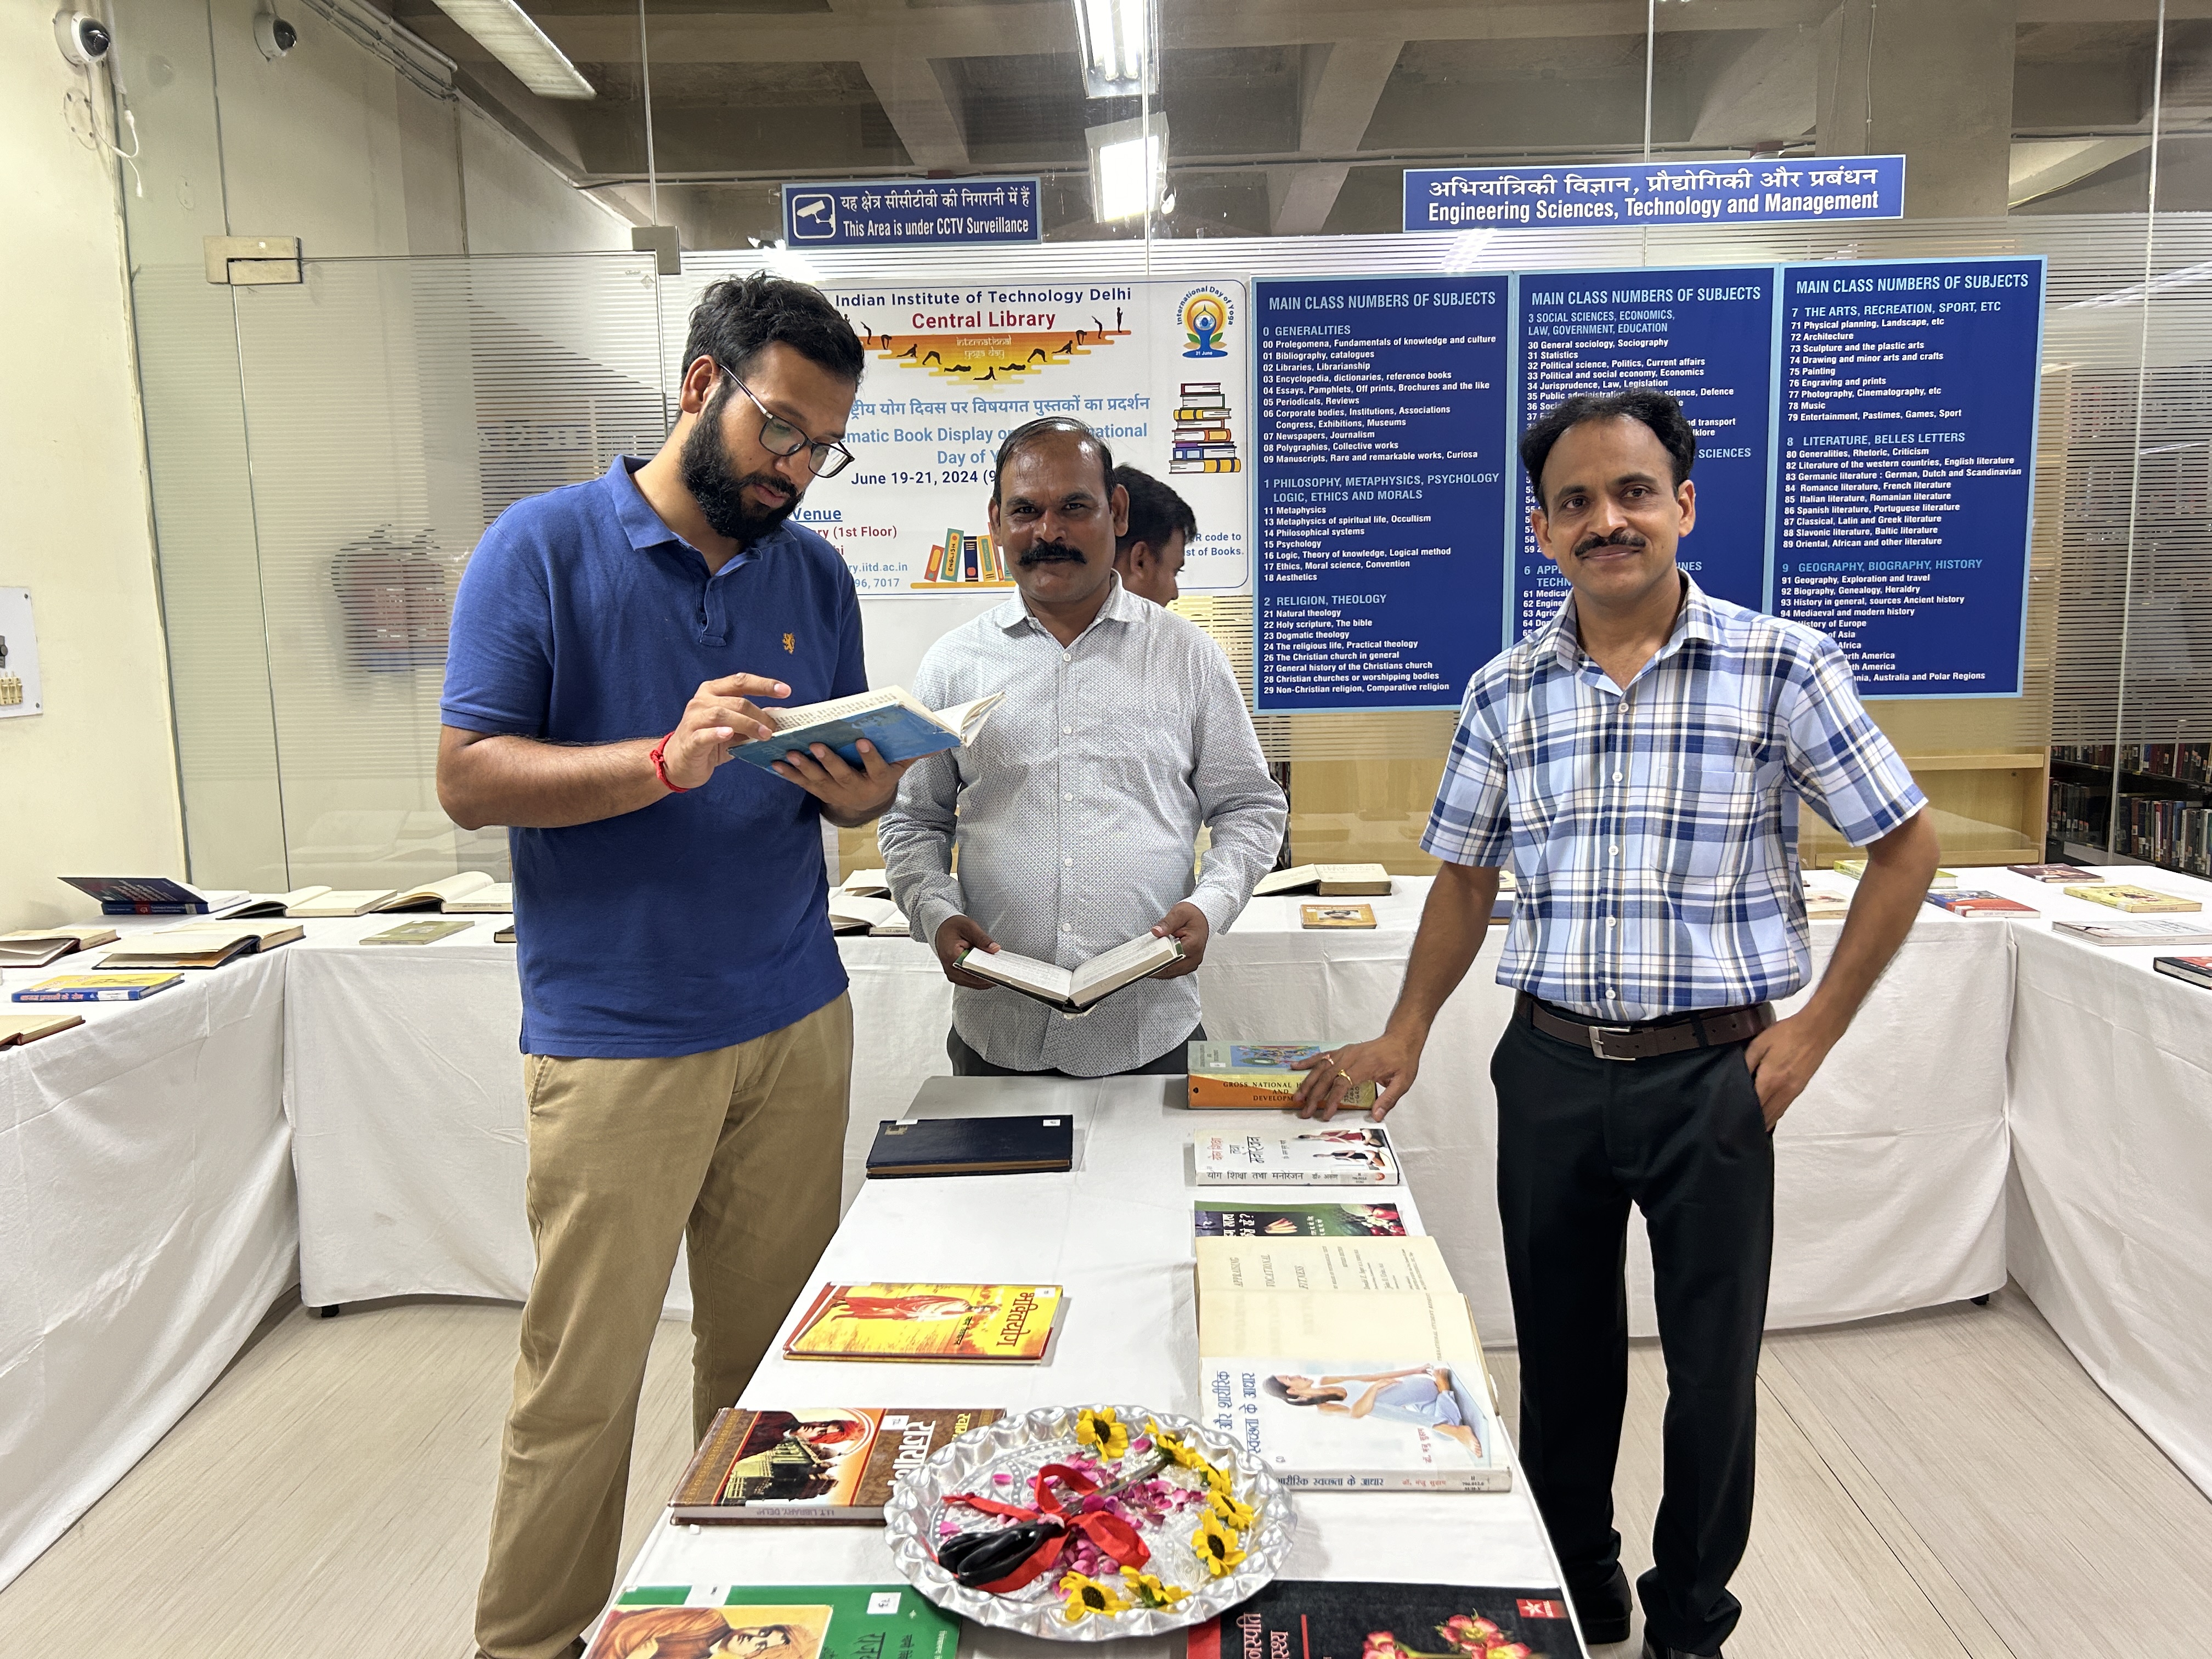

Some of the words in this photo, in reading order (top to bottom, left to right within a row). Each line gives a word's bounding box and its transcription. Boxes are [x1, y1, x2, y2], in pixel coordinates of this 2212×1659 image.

[1429, 173, 1558, 197] अभियांत्रिकी
[1563, 173, 1639, 196] विज्ञान,
[1645, 167, 1754, 192] प्रौद्योगिकी
[1759, 166, 1804, 188] और
[1808, 165, 1879, 187] प्रबंधन
[839, 196, 859, 212] यह
[861, 190, 882, 213] क्षेत्र
[884, 189, 938, 210] सीसीटीवी
[940, 188, 958, 207] की
[961, 187, 1005, 207] निगरानी
[1007, 186, 1018, 205] में
[1020, 186, 1030, 207] हैं
[1429, 201, 1530, 224] Engineering
[1536, 199, 1618, 219] Sciences,
[1624, 196, 1722, 217] Technology
[1727, 194, 1759, 213] and
[1765, 190, 1879, 215] Management
[843, 220, 865, 237] This
[867, 220, 891, 236] Area
[893, 219, 902, 236] is
[905, 218, 934, 235] under
[936, 217, 963, 235] CCTV
[967, 216, 1029, 234] Surveillance
[1796, 280, 1829, 294] MAIN
[1833, 278, 1874, 293] CLASS
[1877, 276, 1940, 291] NUMBERS
[1944, 275, 1961, 289] OF
[1965, 274, 2029, 289] SUBJECTS
[836, 294, 885, 307] Indian
[891, 292, 960, 306] Institute
[966, 291, 982, 304] of
[988, 289, 1084, 304] Technology
[1090, 287, 1131, 301] Delhi
[1269, 296, 1301, 310] MAIN
[1305, 295, 1344, 309] CLASS
[1348, 294, 1409, 308] NUMBERS
[1413, 293, 1430, 307] OF
[1433, 291, 1496, 306] SUBJECTS
[1176, 285, 1207, 325] International
[1209, 286, 1223, 297] Day
[912, 311, 981, 329] Central
[989, 310, 1056, 330] Library
[1263, 326, 1269, 336] 0
[1275, 325, 1351, 336] GENERALITIES
[1528, 325, 1550, 337] LAW,
[1553, 324, 1615, 335] GOVERNMENT,
[1618, 323, 1668, 334] EDUCATION
[1790, 333, 1802, 341] 72
[1803, 332, 1854, 341] Architecture
[956, 336, 1012, 346] international
[964, 350, 986, 360] yoga
[988, 348, 1005, 359] day
[1527, 352, 1537, 360] 31
[1541, 351, 1578, 359] Statistics
[1263, 364, 1273, 372] 02
[1276, 363, 1314, 372] Libraries,
[1317, 362, 1370, 371] Librarianship
[879, 398, 906, 415] योग
[909, 398, 947, 415] दिवस
[950, 402, 969, 414] पर
[972, 397, 1030, 414] विषयगत
[1032, 394, 1081, 416] पुस्तकों
[1084, 398, 1104, 411] का
[1107, 393, 1150, 411] प्रदर्शन
[1276, 397, 1323, 406] Periodicals,
[1325, 397, 1359, 405] Reviews
[1787, 413, 1798, 421] 79
[1800, 412, 1860, 421] Entertainment,
[1863, 411, 1903, 420] Pastimes,
[1905, 410, 1937, 419] Games,
[1939, 409, 1962, 419] Sport
[841, 428, 890, 443] matic
[894, 427, 933, 442] Book
[937, 426, 994, 444] Display
[1088, 422, 1147, 438] national
[937, 450, 966, 466] Day
[970, 449, 986, 464] of
[1698, 447, 1751, 459] SCIENCES
[851, 472, 886, 485] June
[891, 471, 937, 486] 19-21,
[942, 470, 978, 483] 2024
[793, 507, 842, 520] Venue
[833, 526, 857, 540] (1st
[861, 525, 897, 539] Floor)
[1194, 533, 1202, 541] R
[1205, 532, 1229, 541] code
[1231, 533, 1242, 541] to
[1276, 528, 1329, 538] Philosophical
[1331, 528, 1365, 537] systems
[948, 543, 956, 572] ENGLISH
[1186, 548, 1195, 556] st
[1198, 547, 1208, 556] of
[1211, 546, 1244, 556] Books.
[848, 562, 908, 574] ry.iitd.ac.in
[1782, 563, 1789, 573] 9
[1798, 561, 1865, 573] GEOGRAPHY,
[1868, 560, 1932, 571] BIOGRAPHY,
[1935, 559, 1983, 569] HISTORY
[855, 578, 871, 589] 96,
[873, 578, 900, 588] 7017
[1793, 586, 1836, 596] Biography,
[1838, 586, 1883, 595] Genealogy,
[1885, 585, 1921, 594] Heraldry
[1263, 597, 1271, 606] 2
[1277, 595, 1329, 606] RELIGION,
[1331, 594, 1387, 605] THEOLOGY
[1276, 631, 1314, 641] Dogmatic
[1316, 630, 1350, 640] theology
[1207, 1170, 1223, 1180] योग
[1227, 1170, 1248, 1180] शिक्षा
[1251, 1171, 1268, 1180] तथा
[1271, 1170, 1304, 1180] मनोरंजन
[1230, 1257, 1244, 1288] APPRAISING
[1261, 1254, 1277, 1288] VOCATIONAL
[1294, 1265, 1309, 1290] FITNESS
[996, 1291, 1036, 1347] भक्तियोग
[1432, 1330, 1442, 1362] TERNATIONAL
[1214, 1370, 1233, 1408] शारीरिक
[1241, 1372, 1257, 1399] आधार
[1239, 1403, 1259, 1414] के
[1215, 1409, 1233, 1430] और
